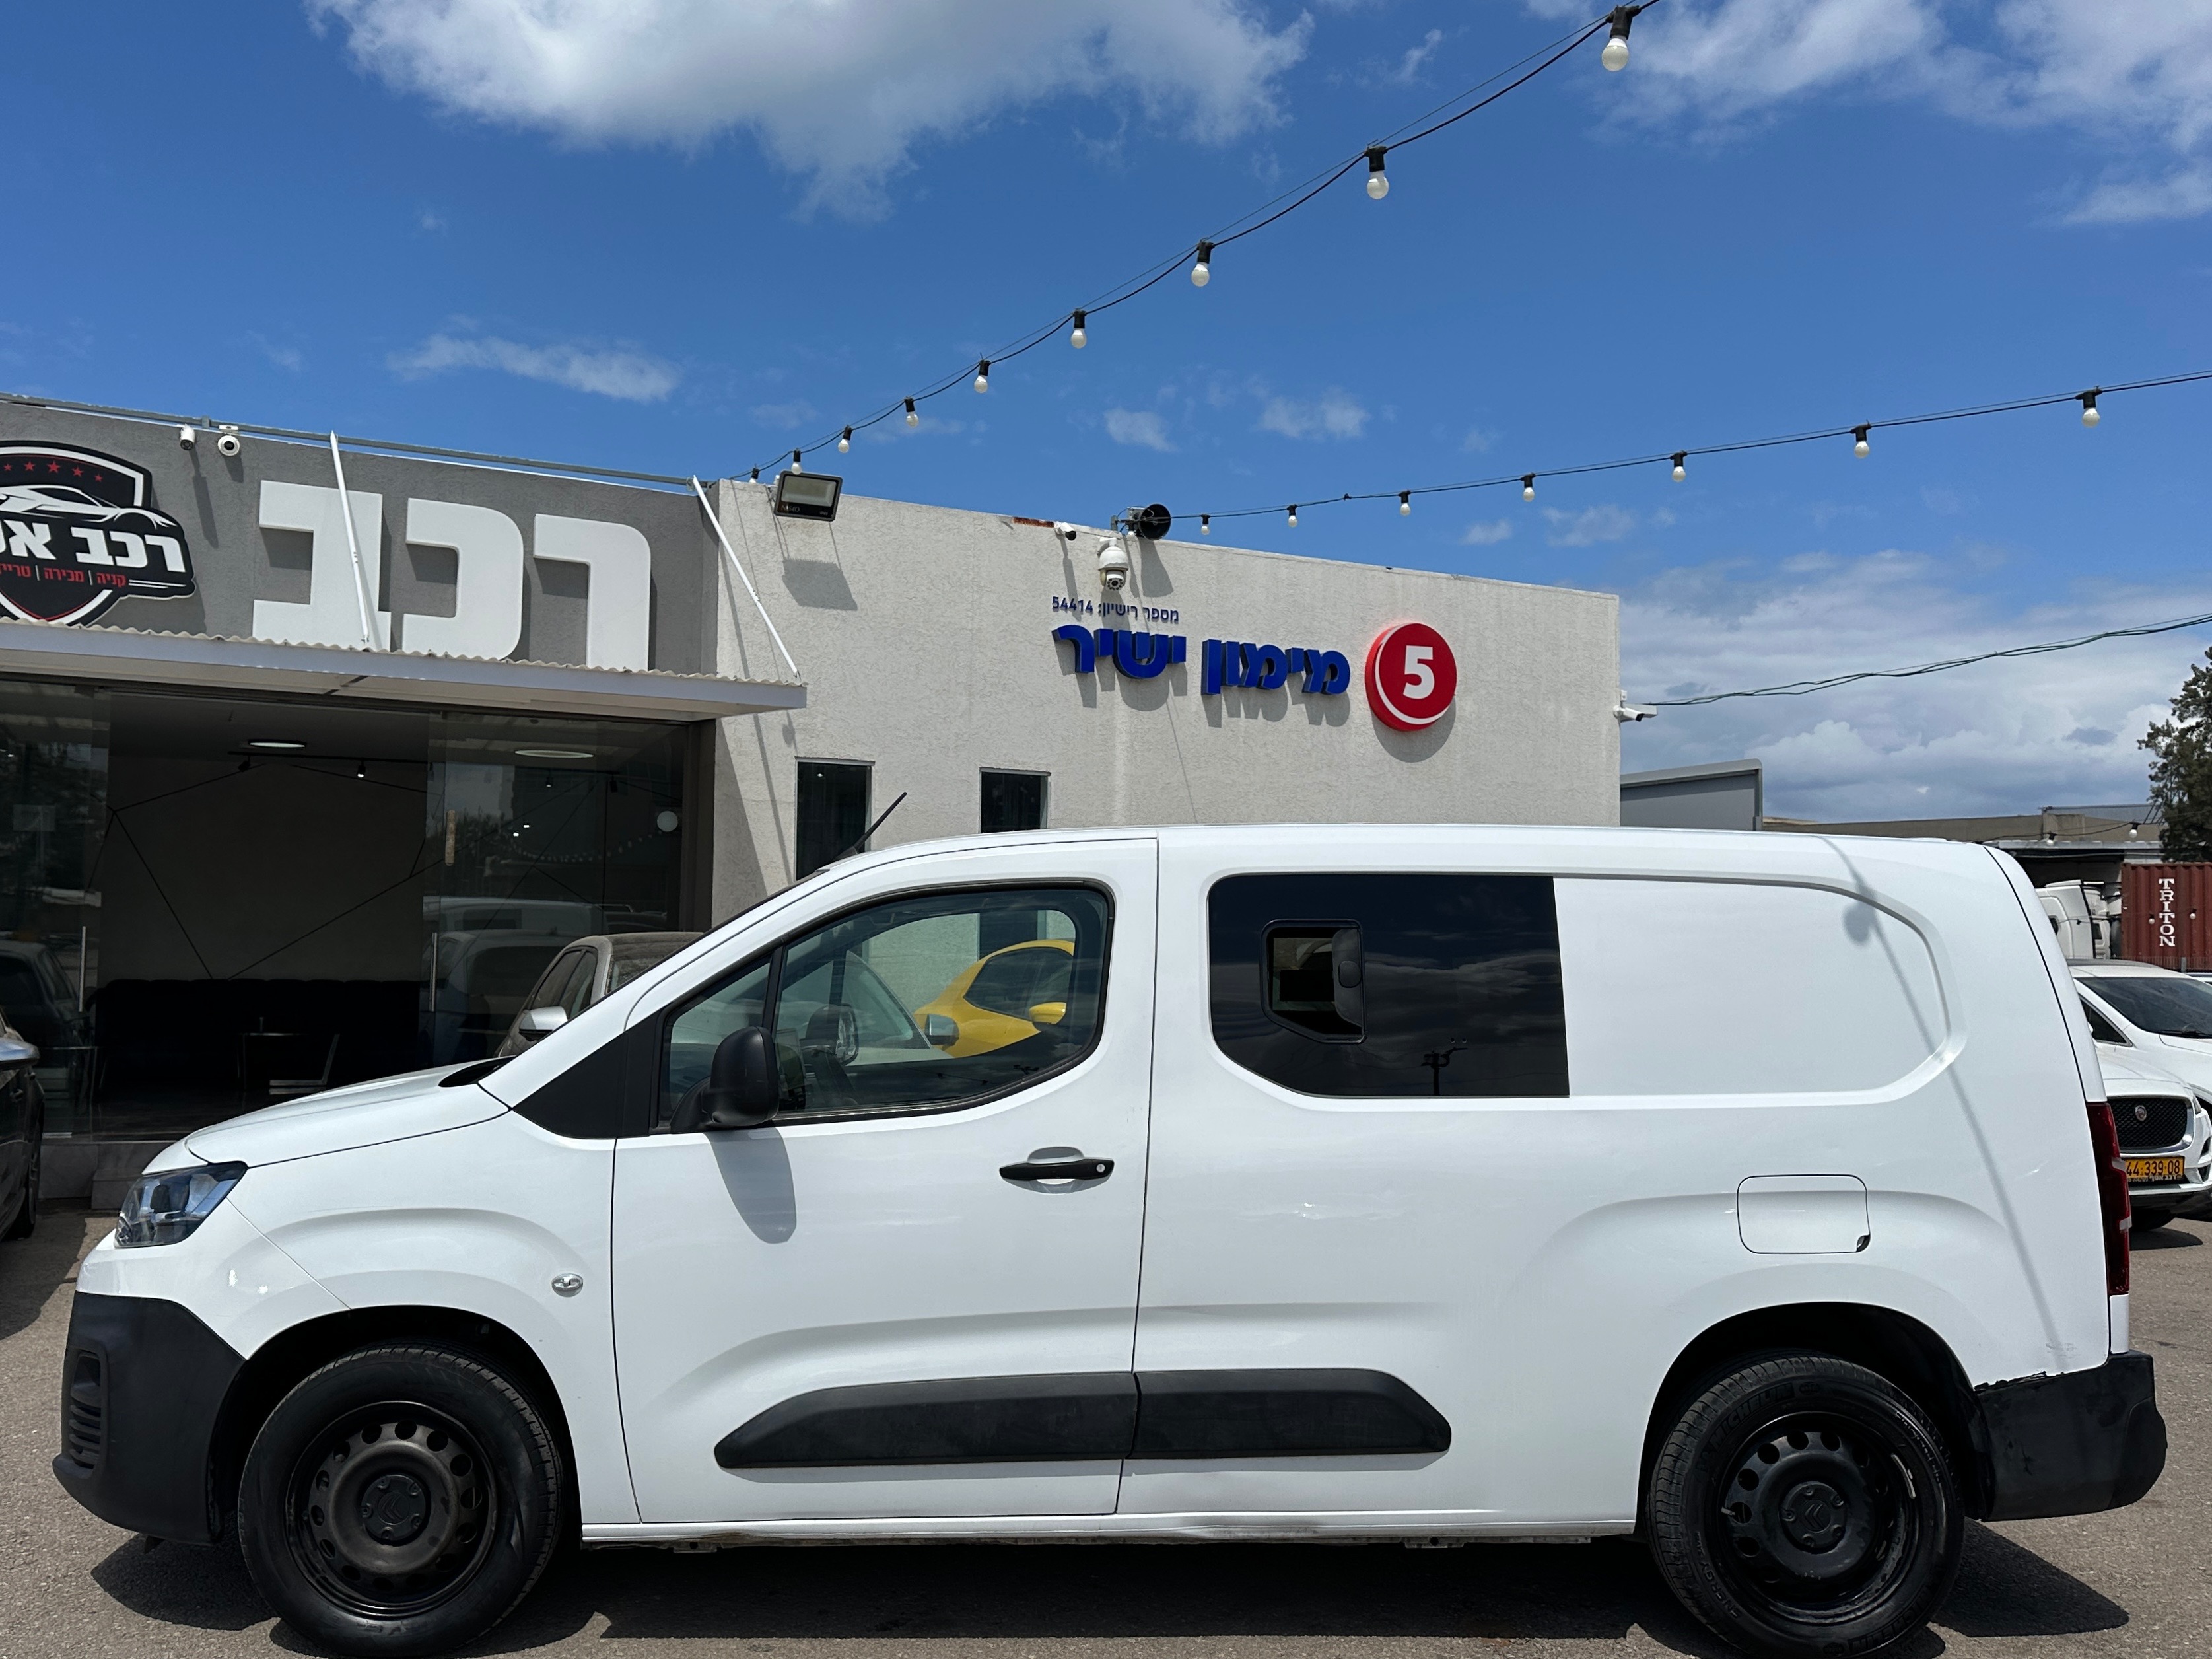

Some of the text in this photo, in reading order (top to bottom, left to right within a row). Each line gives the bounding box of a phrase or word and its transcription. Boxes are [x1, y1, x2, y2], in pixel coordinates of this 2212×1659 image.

[0, 519, 186, 573] רכב א
[43, 567, 85, 582] מכירה
[96, 572, 127, 588] קניה
[252, 480, 651, 672] רכב
[1052, 596, 1179, 622] מספר רישיון: 54414
[1051, 624, 1350, 695] מימון ישיר
[1403, 645, 1434, 700] 5
[2159, 878, 2176, 947] TRITON
[1709, 1382, 1795, 1451] MICHELIN
[1699, 1561, 1741, 1619] ENERGY
